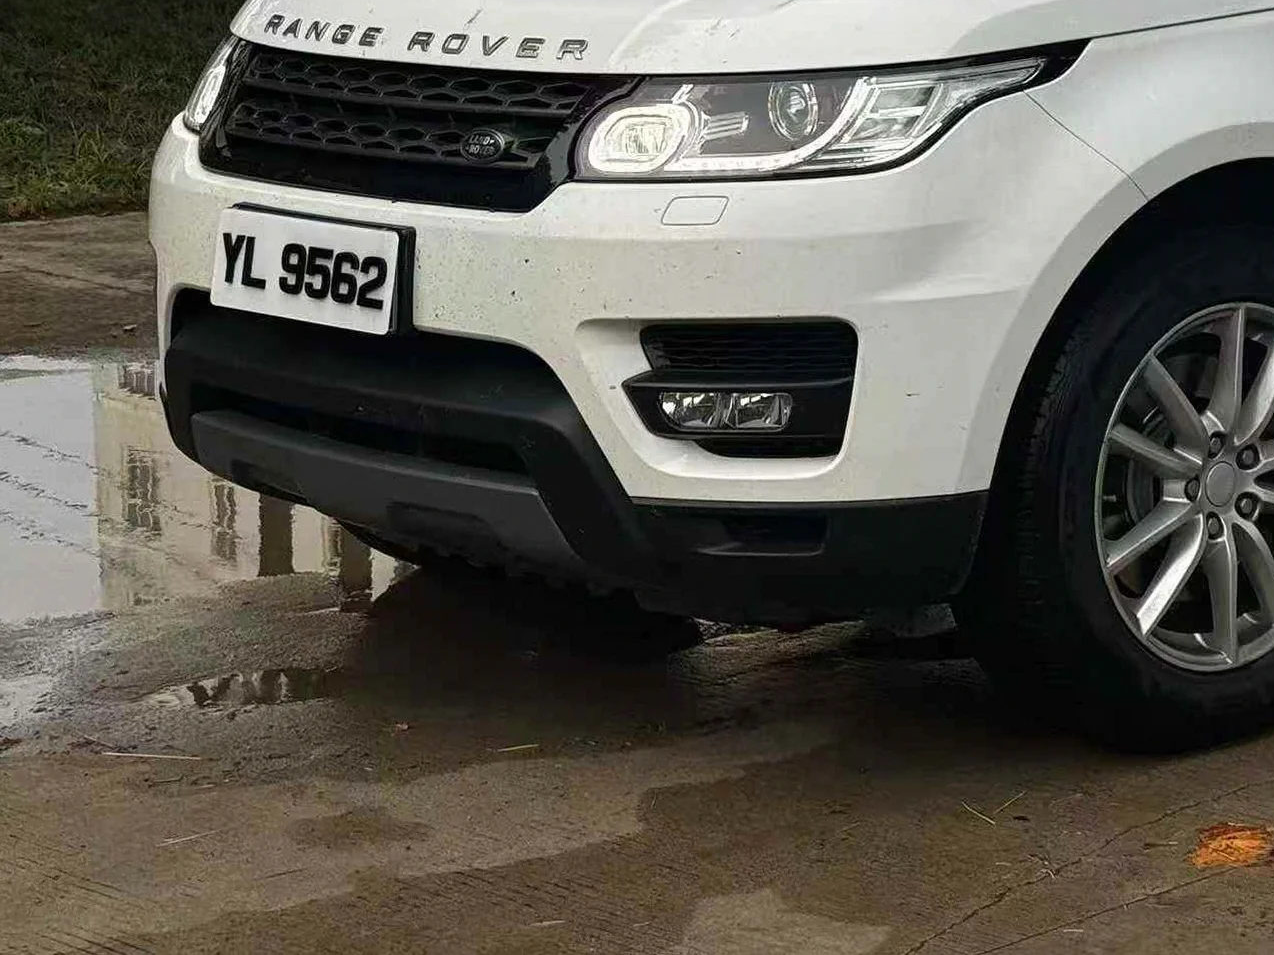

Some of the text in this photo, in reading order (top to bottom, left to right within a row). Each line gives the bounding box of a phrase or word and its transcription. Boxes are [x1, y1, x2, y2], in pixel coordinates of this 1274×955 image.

[264, 14, 589, 60] RANGE ROVER
[222, 232, 388, 311] YL 9562
